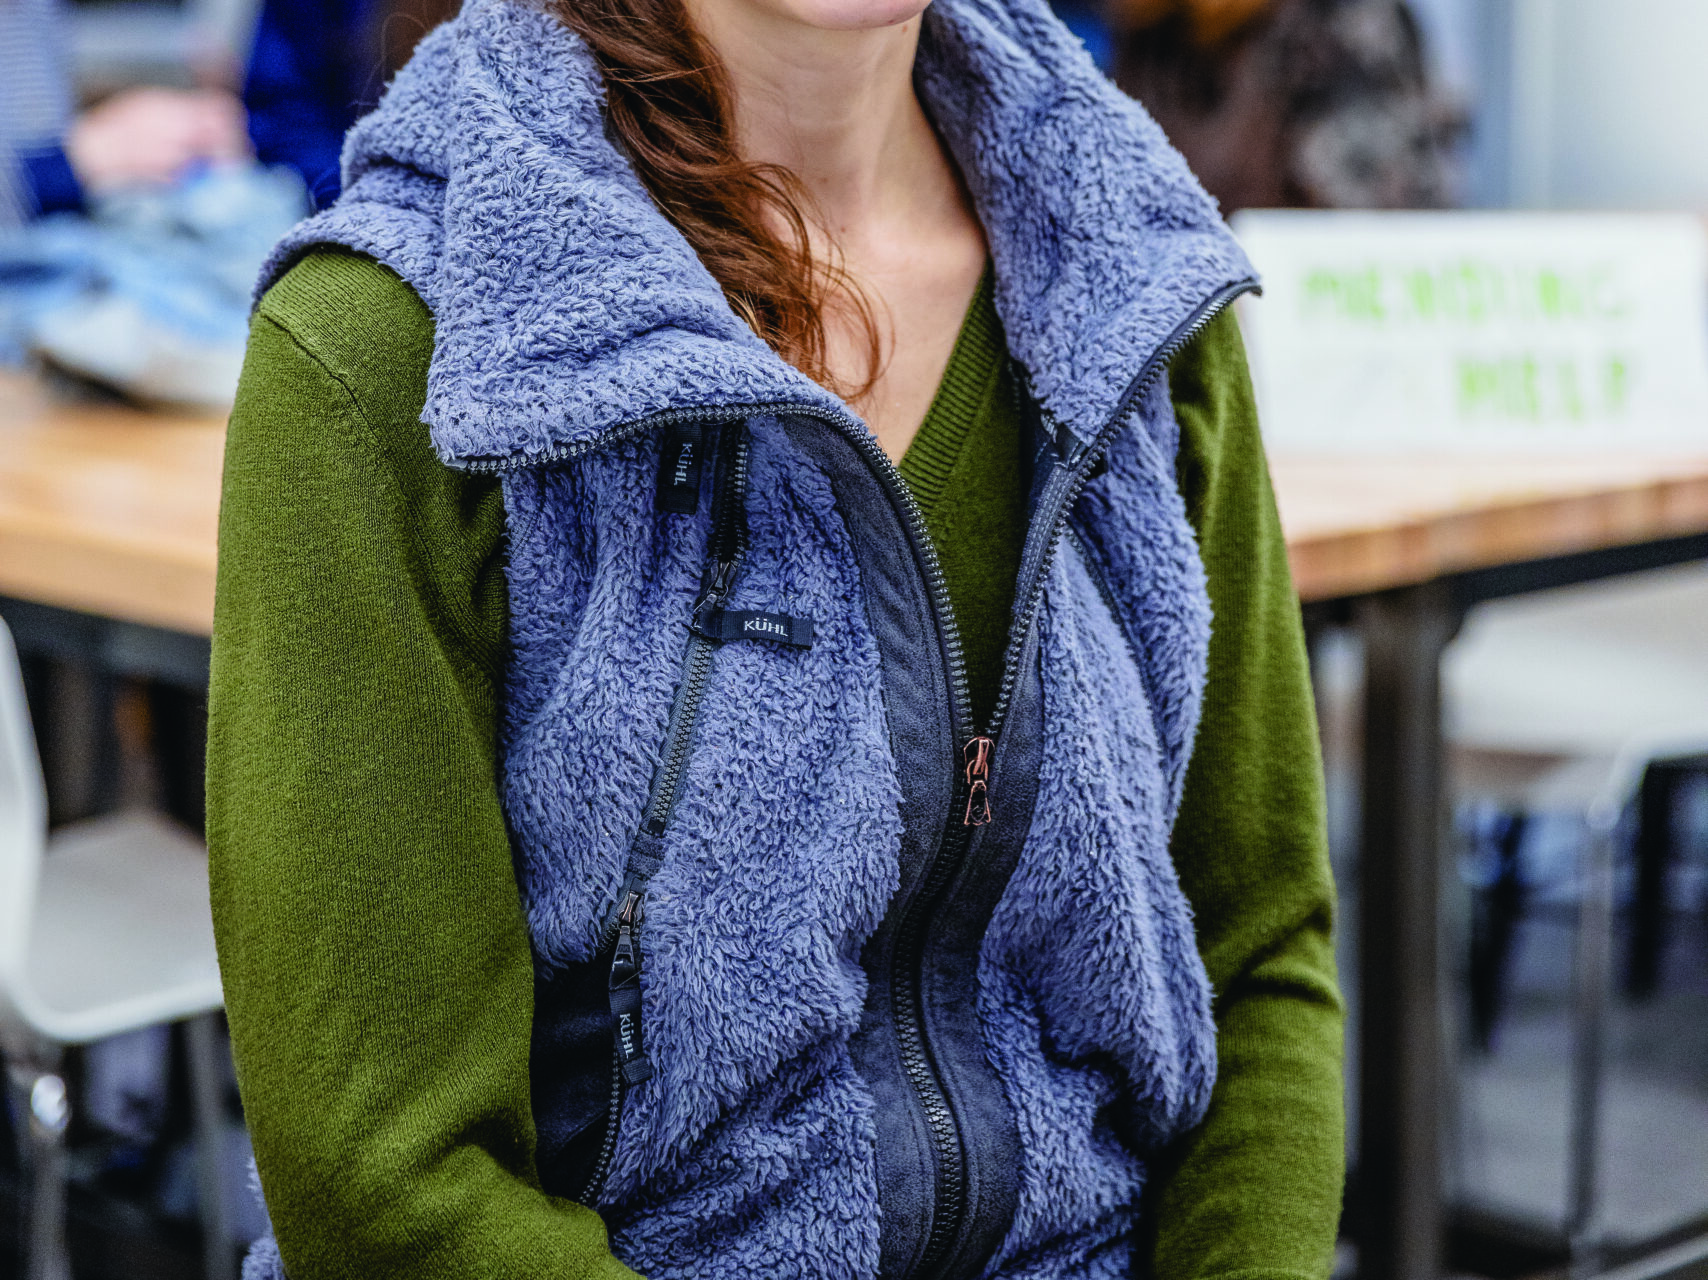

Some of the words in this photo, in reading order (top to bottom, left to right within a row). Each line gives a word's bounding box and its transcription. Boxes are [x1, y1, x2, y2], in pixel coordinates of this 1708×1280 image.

[673, 443, 694, 486] KÜHL
[744, 617, 789, 637] KÜHL
[619, 1012, 635, 1060] KÜHL
